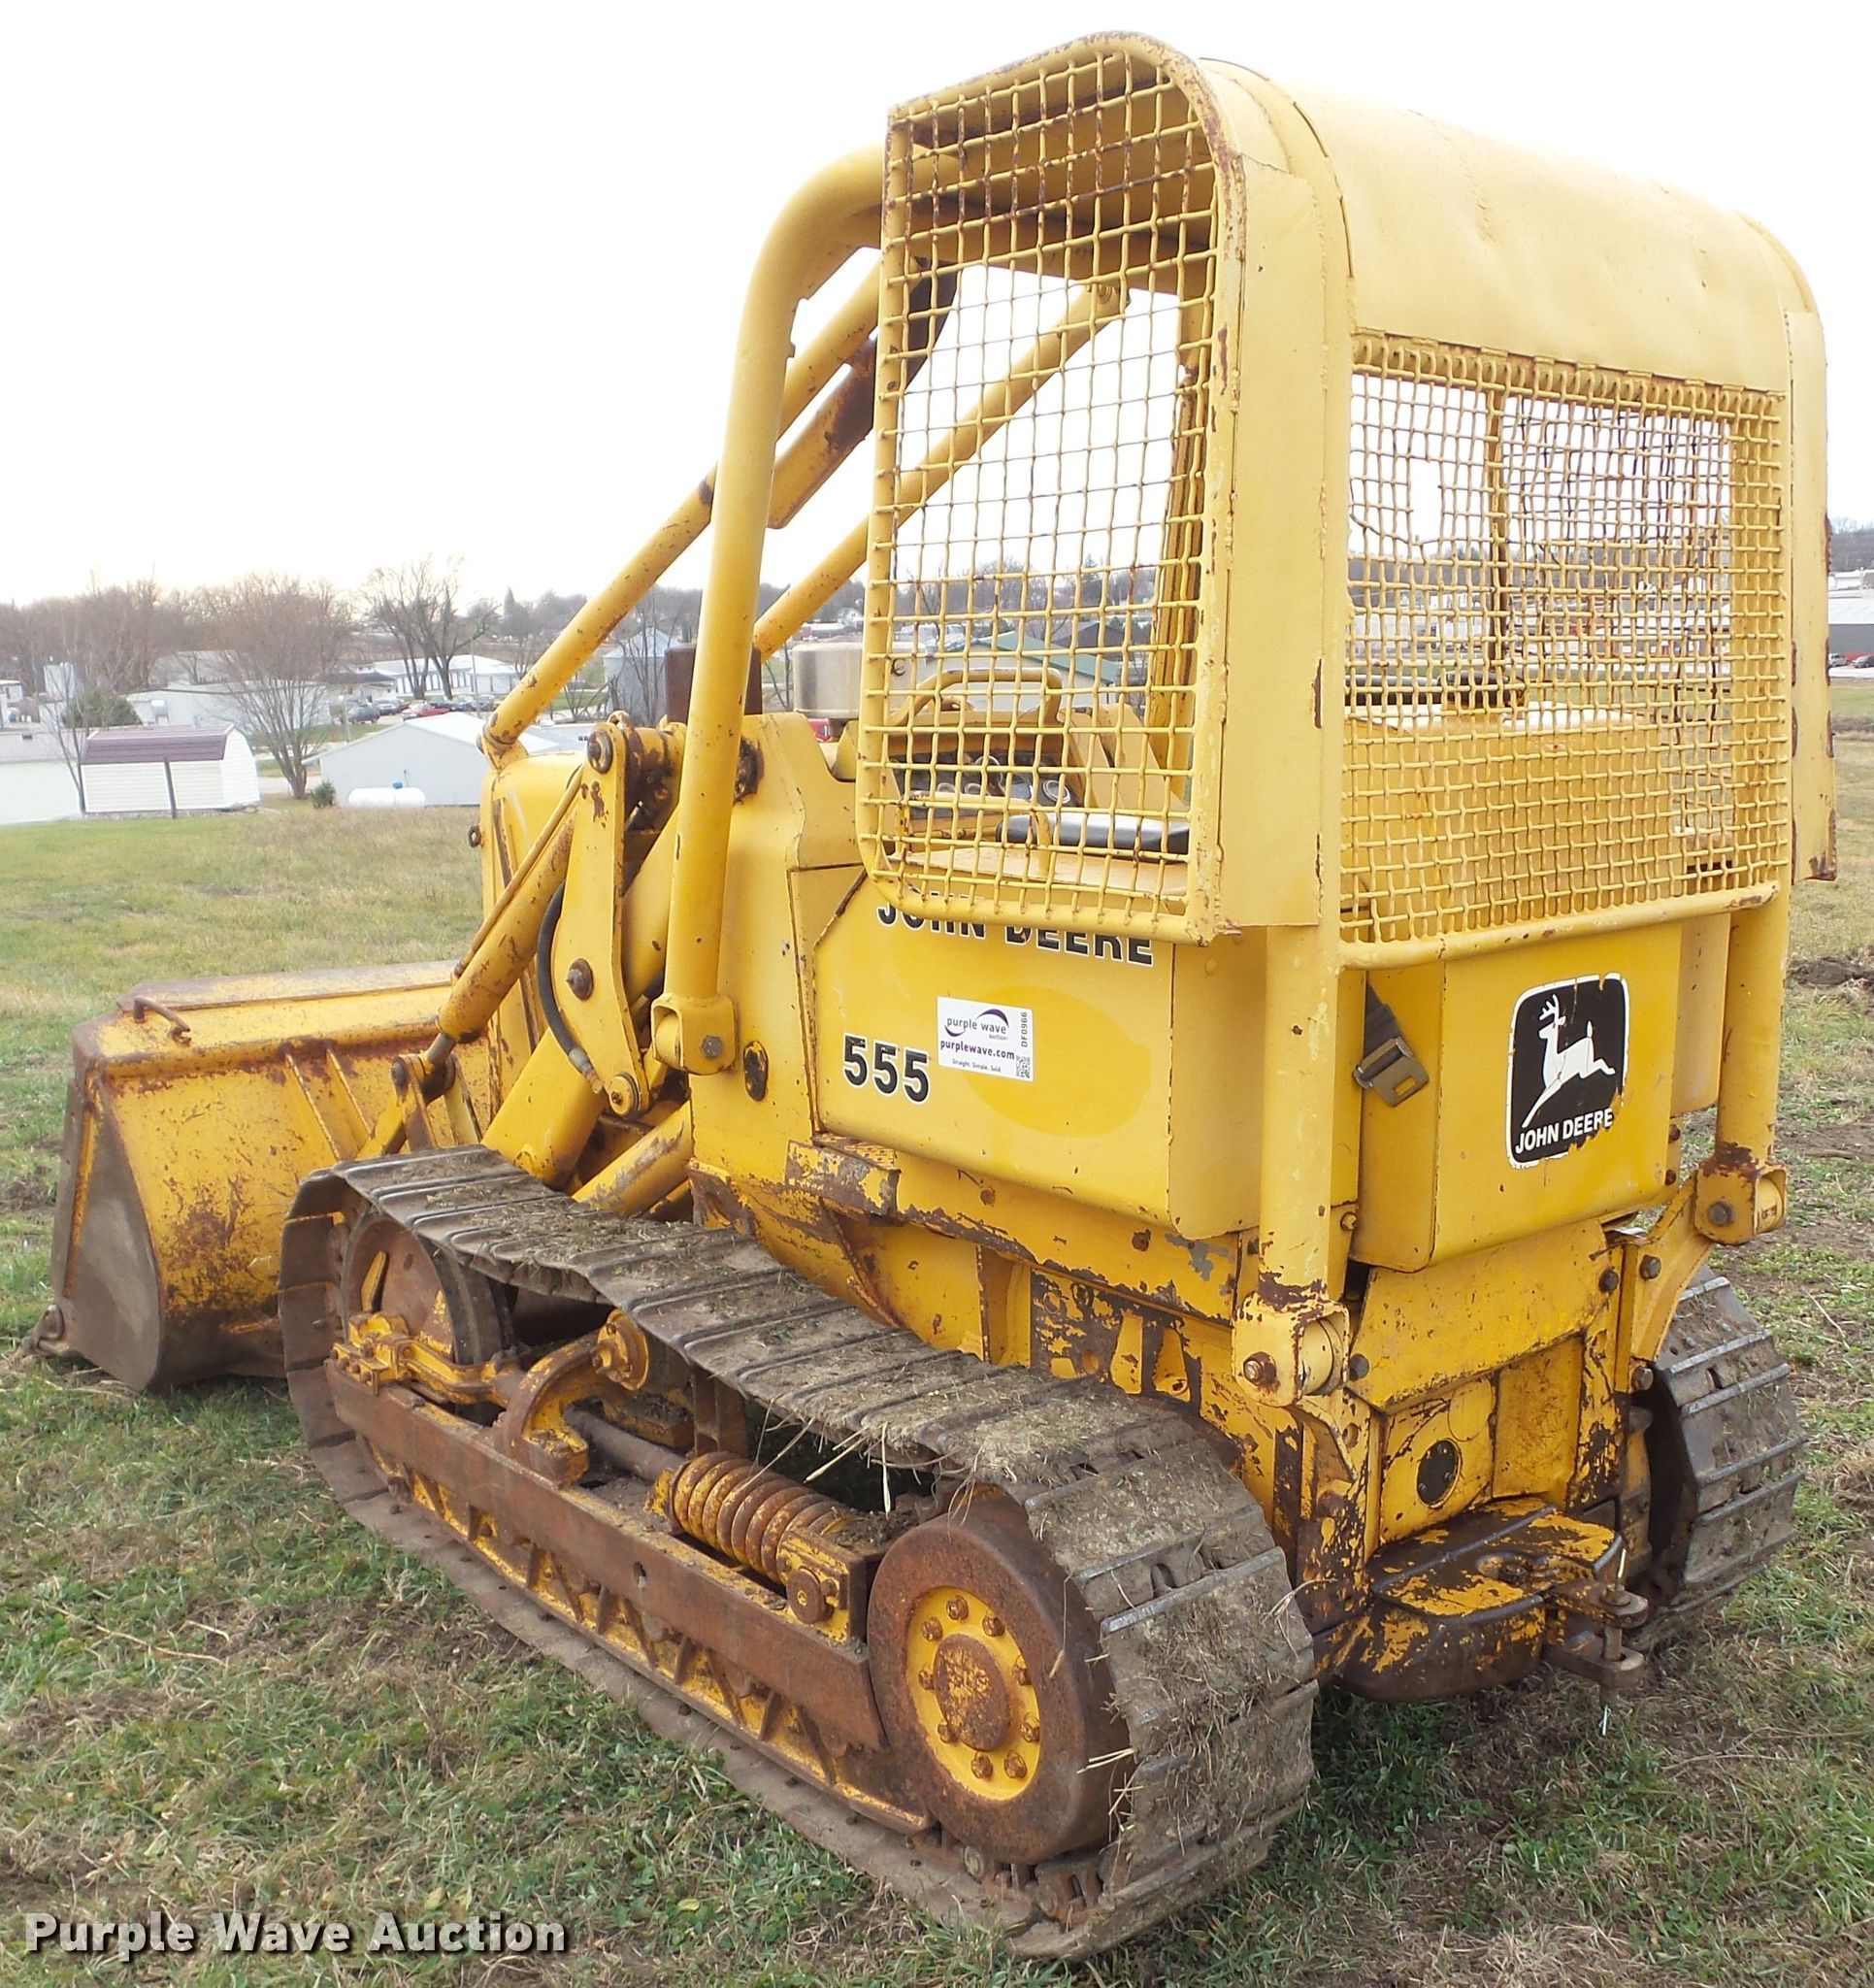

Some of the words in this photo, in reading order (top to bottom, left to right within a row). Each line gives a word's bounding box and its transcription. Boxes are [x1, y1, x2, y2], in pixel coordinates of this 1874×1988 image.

[946, 1017, 977, 1030] purple
[980, 1022, 1006, 1035] wave
[940, 1040, 1015, 1060] purplewave.com
[842, 1033, 931, 1105] 555
[1515, 1122, 1560, 1154] JOHN
[1562, 1108, 1614, 1140] DEERE
